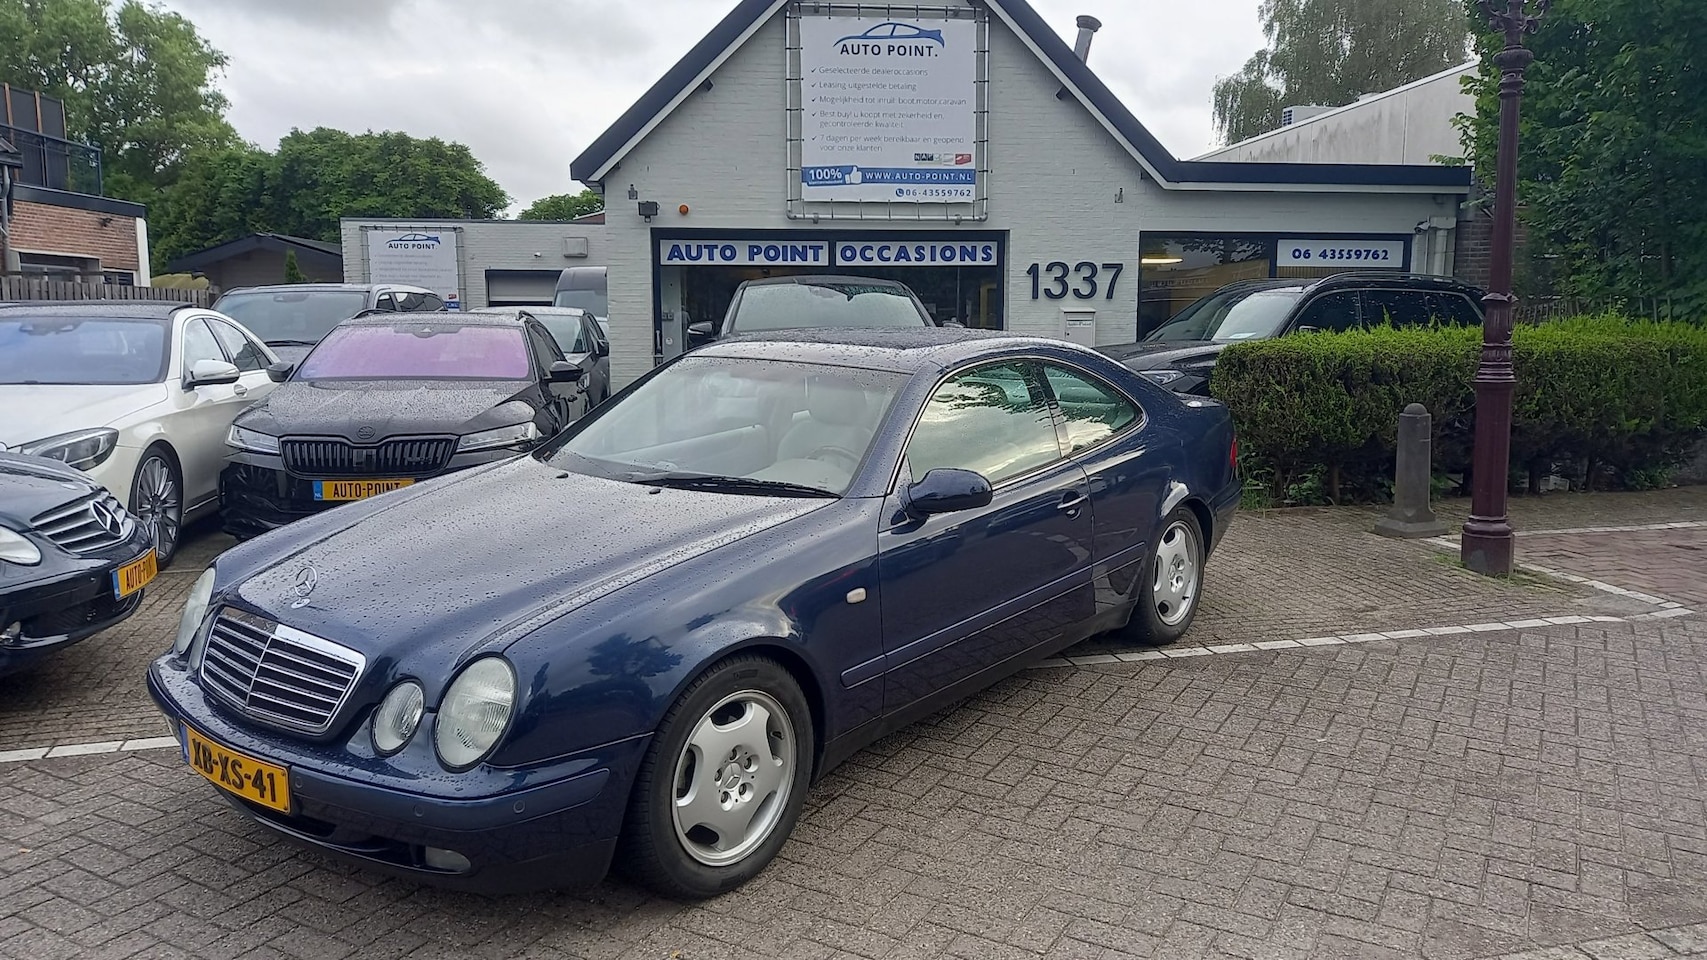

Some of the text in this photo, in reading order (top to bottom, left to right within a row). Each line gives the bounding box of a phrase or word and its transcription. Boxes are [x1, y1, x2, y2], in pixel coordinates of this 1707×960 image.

[840, 44, 938, 57] AUTO POINT.
[819, 66, 928, 76] Geselecteerde dealeroccasions
[819, 81, 917, 92] Leasing uitgestelde betaling
[819, 96, 864, 104] Mogelijkheid
[819, 110, 835, 118] Best
[860, 111, 881, 119] koopt
[819, 121, 873, 129] gecontroleerde
[826, 134, 849, 143] dagen
[883, 135, 921, 143] bereikbaar
[856, 144, 883, 152] klanten
[809, 168, 842, 180] 100%
[865, 171, 972, 181] WWW.AUTO-POINT.NL
[905, 188, 971, 197] 06-43559762
[667, 244, 823, 262] AUTO POINT
[840, 245, 993, 262] OCCASIONS
[1291, 248, 1389, 260] 06 43559762
[1026, 261, 1124, 300] 1337
[191, 738, 277, 803] XB-XS-41
